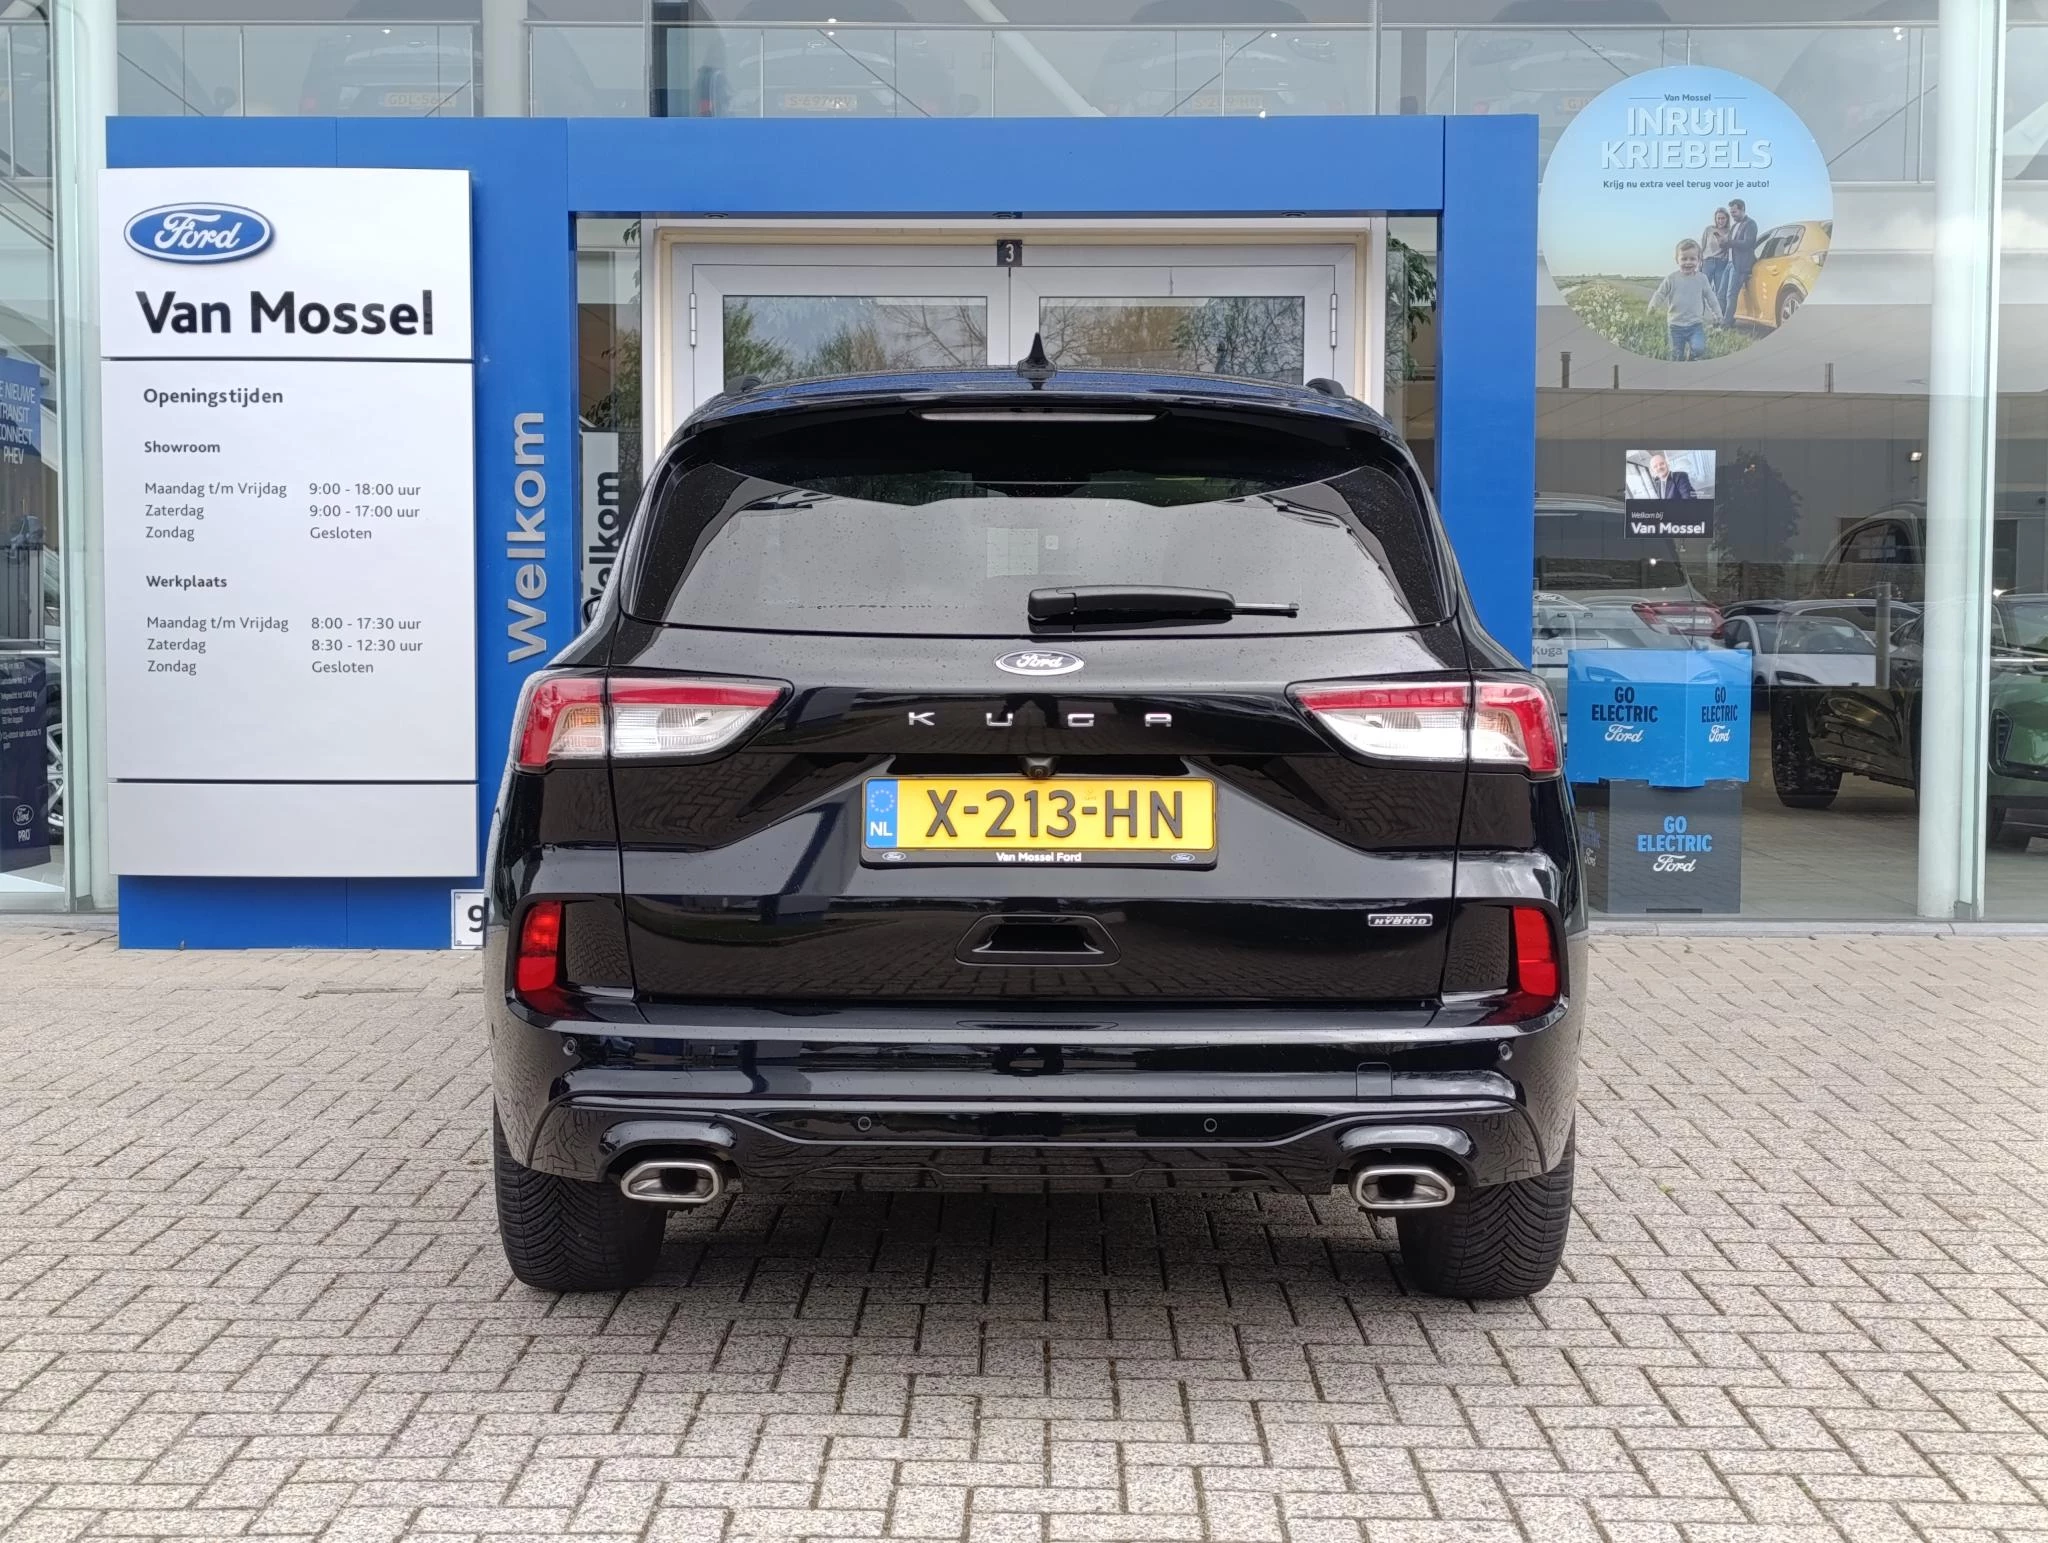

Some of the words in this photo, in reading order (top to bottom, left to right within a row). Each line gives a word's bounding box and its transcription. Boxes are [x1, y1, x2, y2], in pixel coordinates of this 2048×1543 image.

[1627, 104, 1747, 136] INRUIL
[1601, 140, 1773, 169] KRIEBELS
[1603, 180, 1624, 189] Krijg
[1666, 180, 1684, 188] veel
[1687, 181, 1710, 189] terug
[1735, 180, 1745, 189] je
[1747, 180, 1769, 188] auto!
[153, 212, 242, 249] Ford
[1006, 244, 1014, 262] 3
[135, 291, 231, 333] Van
[250, 290, 433, 335] Mossel
[5, 381, 36, 404] NIEUWE
[143, 388, 283, 408] Openingstijden
[144, 440, 221, 453] Showroom
[3, 446, 25, 465] PHEV
[145, 482, 205, 498] Maandag
[208, 482, 234, 494] t/m
[238, 482, 287, 498] Vrijdag
[309, 483, 341, 495] 9:00
[355, 483, 394, 495] 18:00
[398, 486, 421, 496] uur
[145, 504, 204, 520] Zaterdag
[309, 505, 341, 517] 9:00
[355, 505, 393, 517] 17:00
[397, 508, 420, 518] uur
[1656, 512, 1664, 520] bij
[145, 525, 195, 542] Zondag
[310, 526, 372, 539] Gesloten
[1631, 522, 1655, 534] Van
[1660, 521, 1705, 534] Mossel
[507, 412, 547, 663] Welkom
[146, 575, 228, 591] Werkplaats
[147, 616, 207, 632] Maandag
[211, 616, 236, 629] t/m
[240, 616, 289, 632] Vrijdag
[311, 617, 343, 629] 8:00
[356, 617, 394, 629] 17:30
[398, 620, 422, 630] uur
[147, 637, 206, 654] Zaterdag
[311, 639, 343, 651] 8:30
[356, 639, 395, 651] 12:30
[400, 642, 423, 651] uur
[1532, 646, 1562, 657] Kuga
[147, 660, 196, 676] Zondag
[312, 661, 374, 673] Gesloten
[1016, 653, 1063, 668] Ford
[1615, 686, 1635, 703] GO
[1715, 687, 1726, 703] GO
[908, 712, 1173, 728] KUGA
[1592, 704, 1658, 723] ELECTRIC
[1702, 704, 1738, 723] ELECTRIC
[1604, 723, 1644, 742] Ford
[1709, 725, 1731, 743] Ford
[926, 789, 1183, 839] X-213-HN
[870, 822, 893, 837] NL
[1664, 815, 1687, 833] GO
[18, 829, 31, 842] PRO
[1637, 834, 1713, 852] ELECTRIC
[996, 852, 1017, 862] Van
[1018, 852, 1054, 862] Mossel
[1056, 852, 1081, 862] Ford
[1653, 854, 1697, 872] Ford
